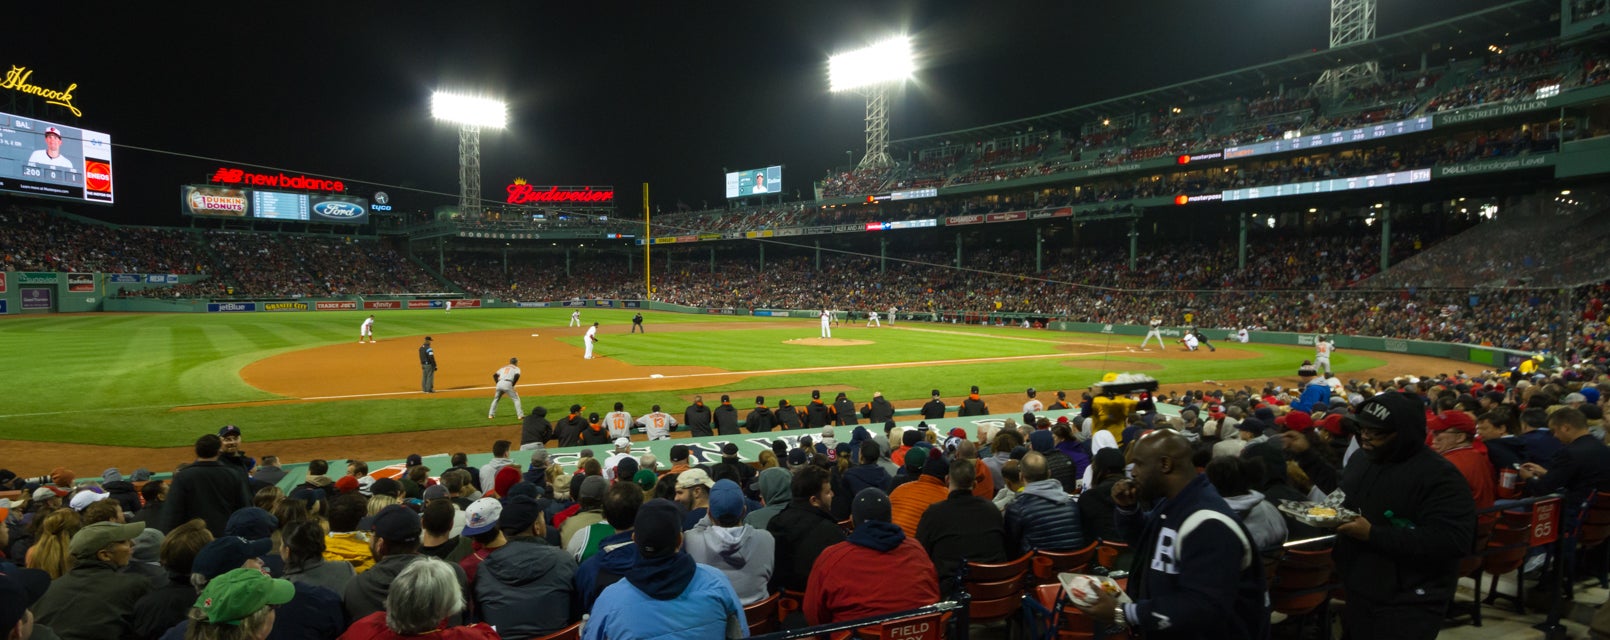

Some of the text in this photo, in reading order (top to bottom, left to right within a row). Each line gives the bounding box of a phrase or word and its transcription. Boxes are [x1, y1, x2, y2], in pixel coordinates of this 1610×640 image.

[0, 64, 82, 117] Hancock
[1442, 100, 1548, 124] STATE STREET PAVILION
[15, 120, 31, 129] BAL
[1190, 153, 1222, 161] masterpass
[1442, 156, 1545, 175] DELL Technologies Level
[24, 168, 41, 177] .200
[87, 171, 110, 181] ENEOS
[244, 173, 279, 187] new
[280, 173, 345, 192] balance
[506, 183, 614, 204] Budweiser
[1188, 194, 1222, 202] masterpass
[206, 202, 242, 211] DONUTS
[323, 203, 355, 216] Ford
[371, 203, 392, 211] tyco
[219, 303, 246, 312] jetBlue
[265, 302, 308, 310] GRANITE CITY
[372, 301, 392, 309] xfinity
[1363, 401, 1391, 421] LYN
[613, 418, 625, 430] 10
[653, 417, 665, 428] 13
[1534, 521, 1552, 538] 65
[1150, 526, 1180, 575] R
[890, 622, 930, 638] FIELD
